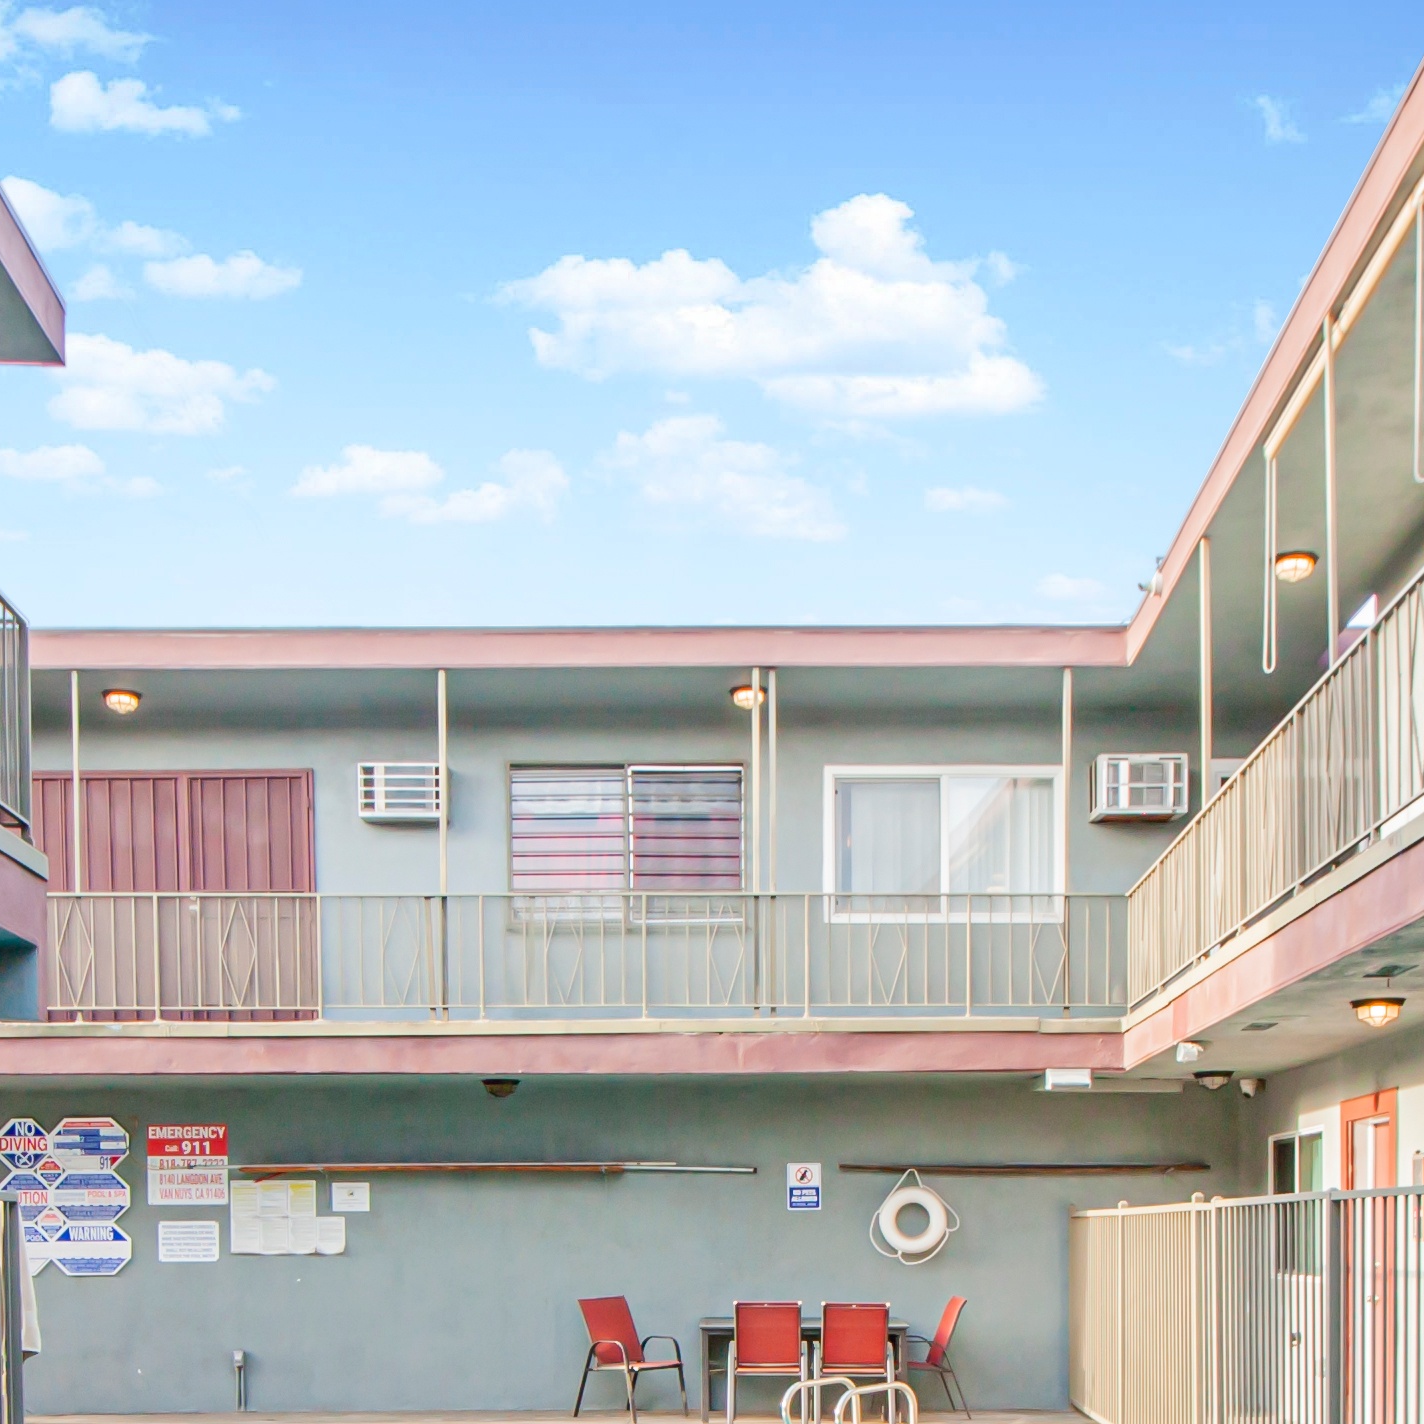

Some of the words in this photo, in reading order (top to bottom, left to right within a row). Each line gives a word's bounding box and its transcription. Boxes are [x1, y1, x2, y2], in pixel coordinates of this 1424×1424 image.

[14, 1121, 35, 1136] NO
[148, 1126, 225, 1139] EMERGENCY
[0, 1137, 48, 1151] DIVING
[181, 1140, 211, 1155] 911
[99, 1156, 112, 1170] 911
[18, 1191, 48, 1205] TION
[69, 1226, 114, 1241] WARNING
